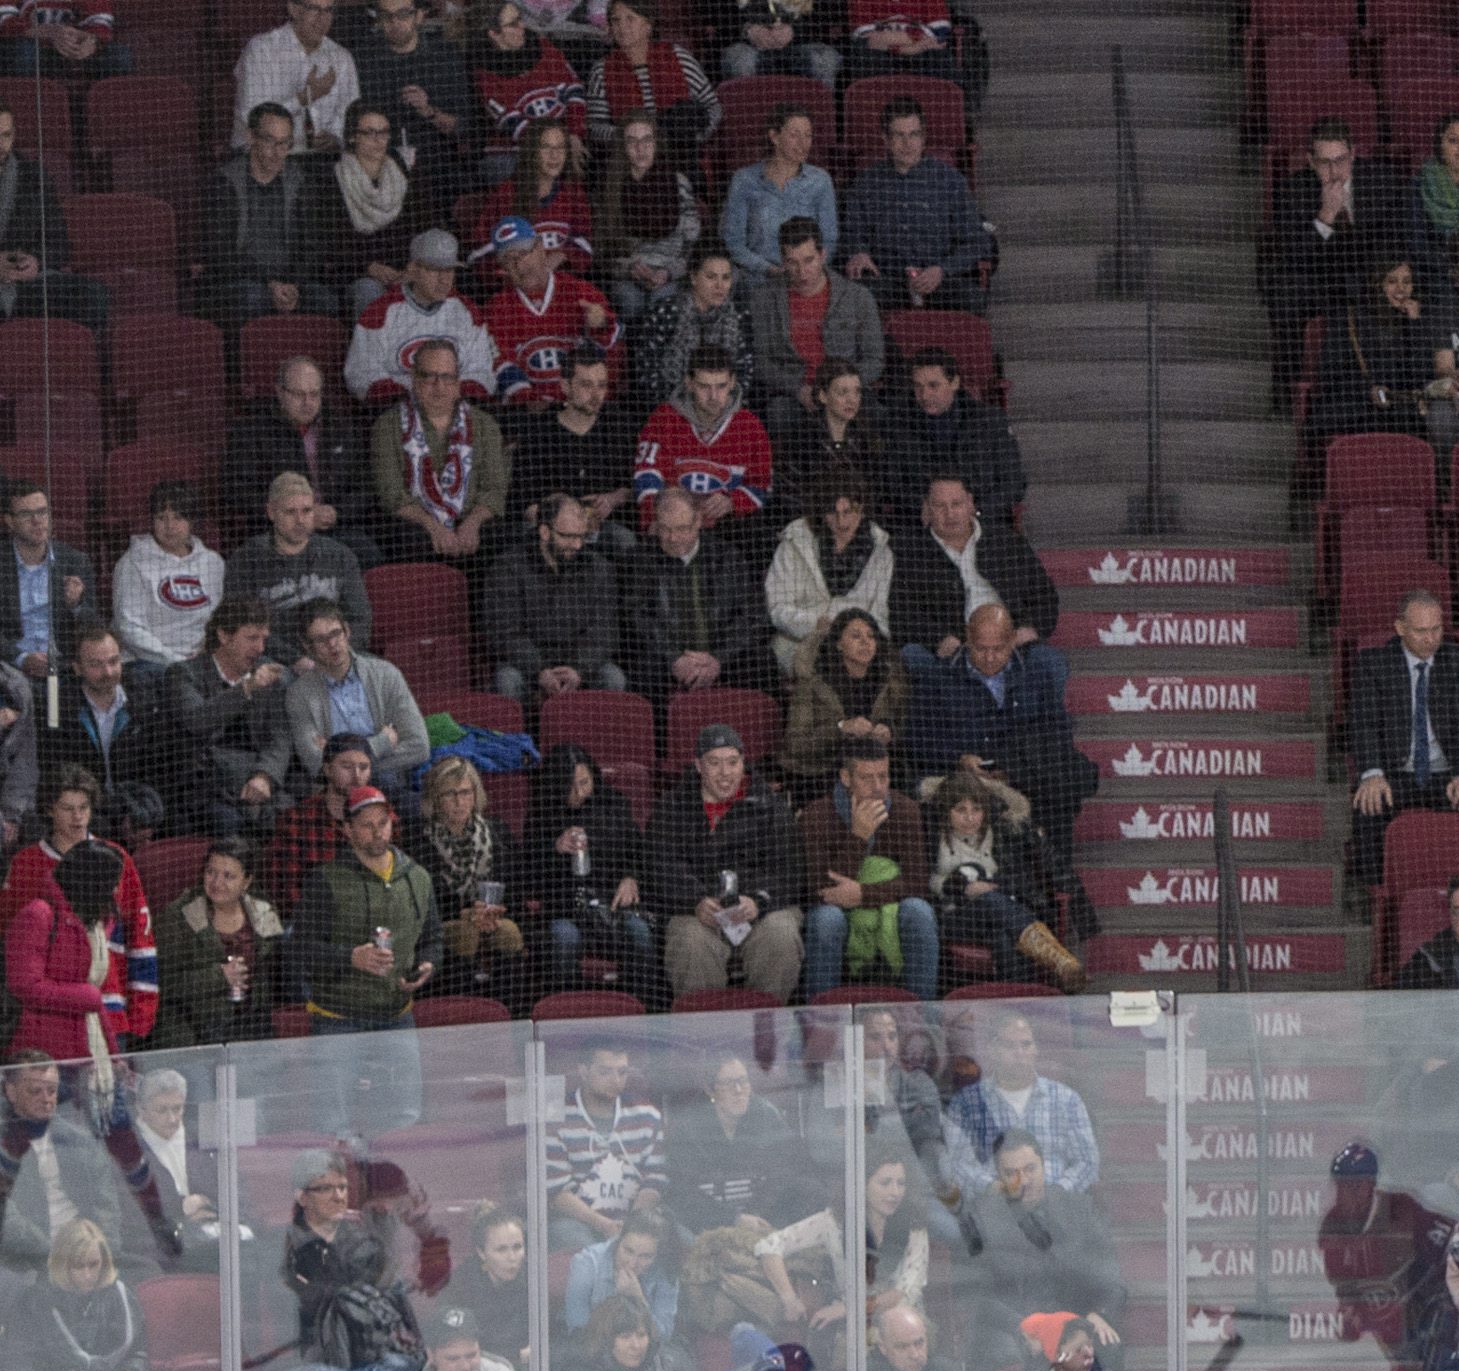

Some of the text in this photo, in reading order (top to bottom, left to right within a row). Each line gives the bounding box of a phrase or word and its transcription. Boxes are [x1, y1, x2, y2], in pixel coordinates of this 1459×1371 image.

[1127, 557, 1236, 583] CANADIAN
[1136, 619, 1247, 645] CANADIAN
[1146, 684, 1257, 710] CANADIAN
[1150, 750, 1262, 775] CANADIAN
[1158, 812, 1270, 838] CANAIAN
[1166, 876, 1279, 903] CANIAN
[1178, 944, 1291, 970] CANIAN
[1203, 1074, 1309, 1100] ANAIAN
[601, 1181, 625, 1200] CAC
[1211, 1250, 1326, 1276] CANDIAN
[1220, 1313, 1344, 1340] CDIAN
